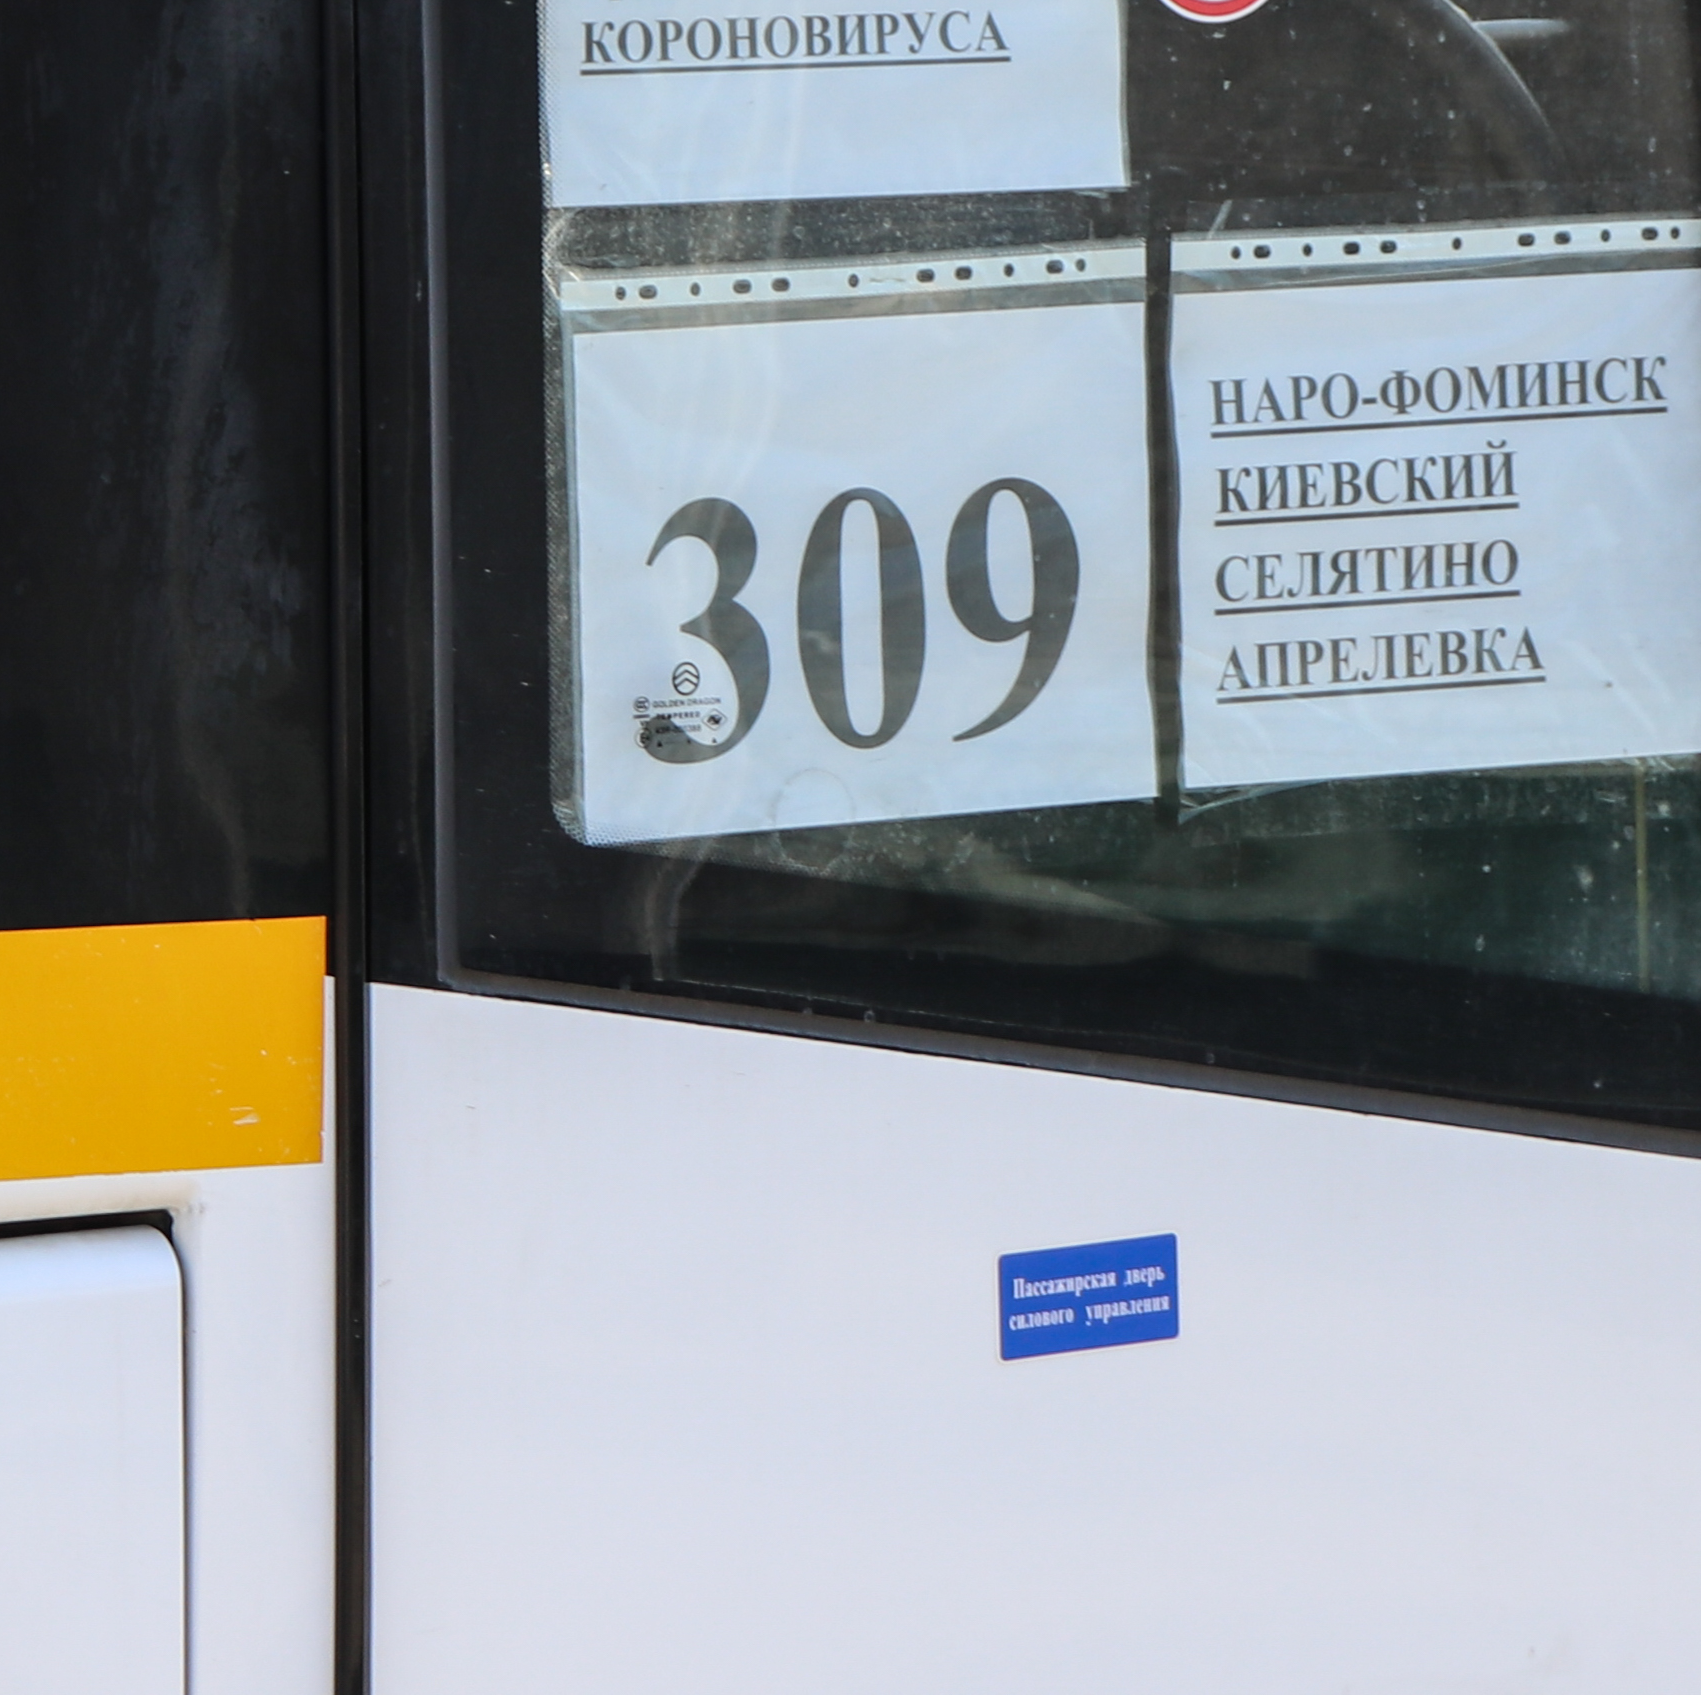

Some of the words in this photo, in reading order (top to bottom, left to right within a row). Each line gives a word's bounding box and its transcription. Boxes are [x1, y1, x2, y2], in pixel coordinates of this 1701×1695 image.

[580, 9, 1010, 65] КОРОНОВИРУСА
[1210, 356, 1667, 426] НАРО-ФОМИНСК
[1216, 440, 1518, 514] КИЕВСКИЙ
[1215, 538, 1519, 603] СЕЛЯТИНО
[645, 476, 1081, 764] 309
[1217, 627, 1544, 693] АПРЕЛЕВКА
[1008, 1306, 1075, 1331] силового
[1084, 1294, 1170, 1326] управления
[1013, 1270, 1117, 1300] Пассажирская
[1123, 1264, 1166, 1289] дверь
